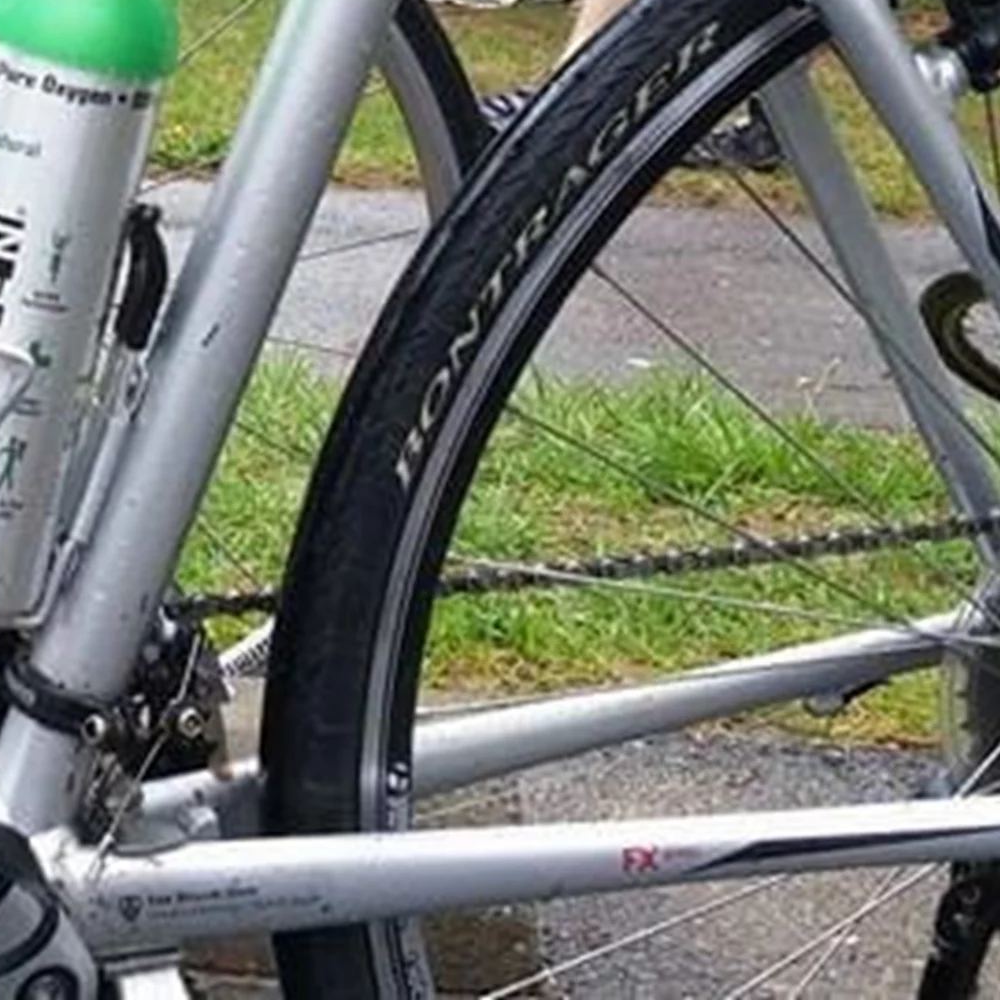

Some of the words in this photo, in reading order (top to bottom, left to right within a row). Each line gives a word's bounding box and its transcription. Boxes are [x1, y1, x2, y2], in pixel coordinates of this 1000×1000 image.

[41, 72, 113, 107] Oxygen
[396, 20, 720, 490] BONTRAGER
[621, 844, 660, 874] FX
